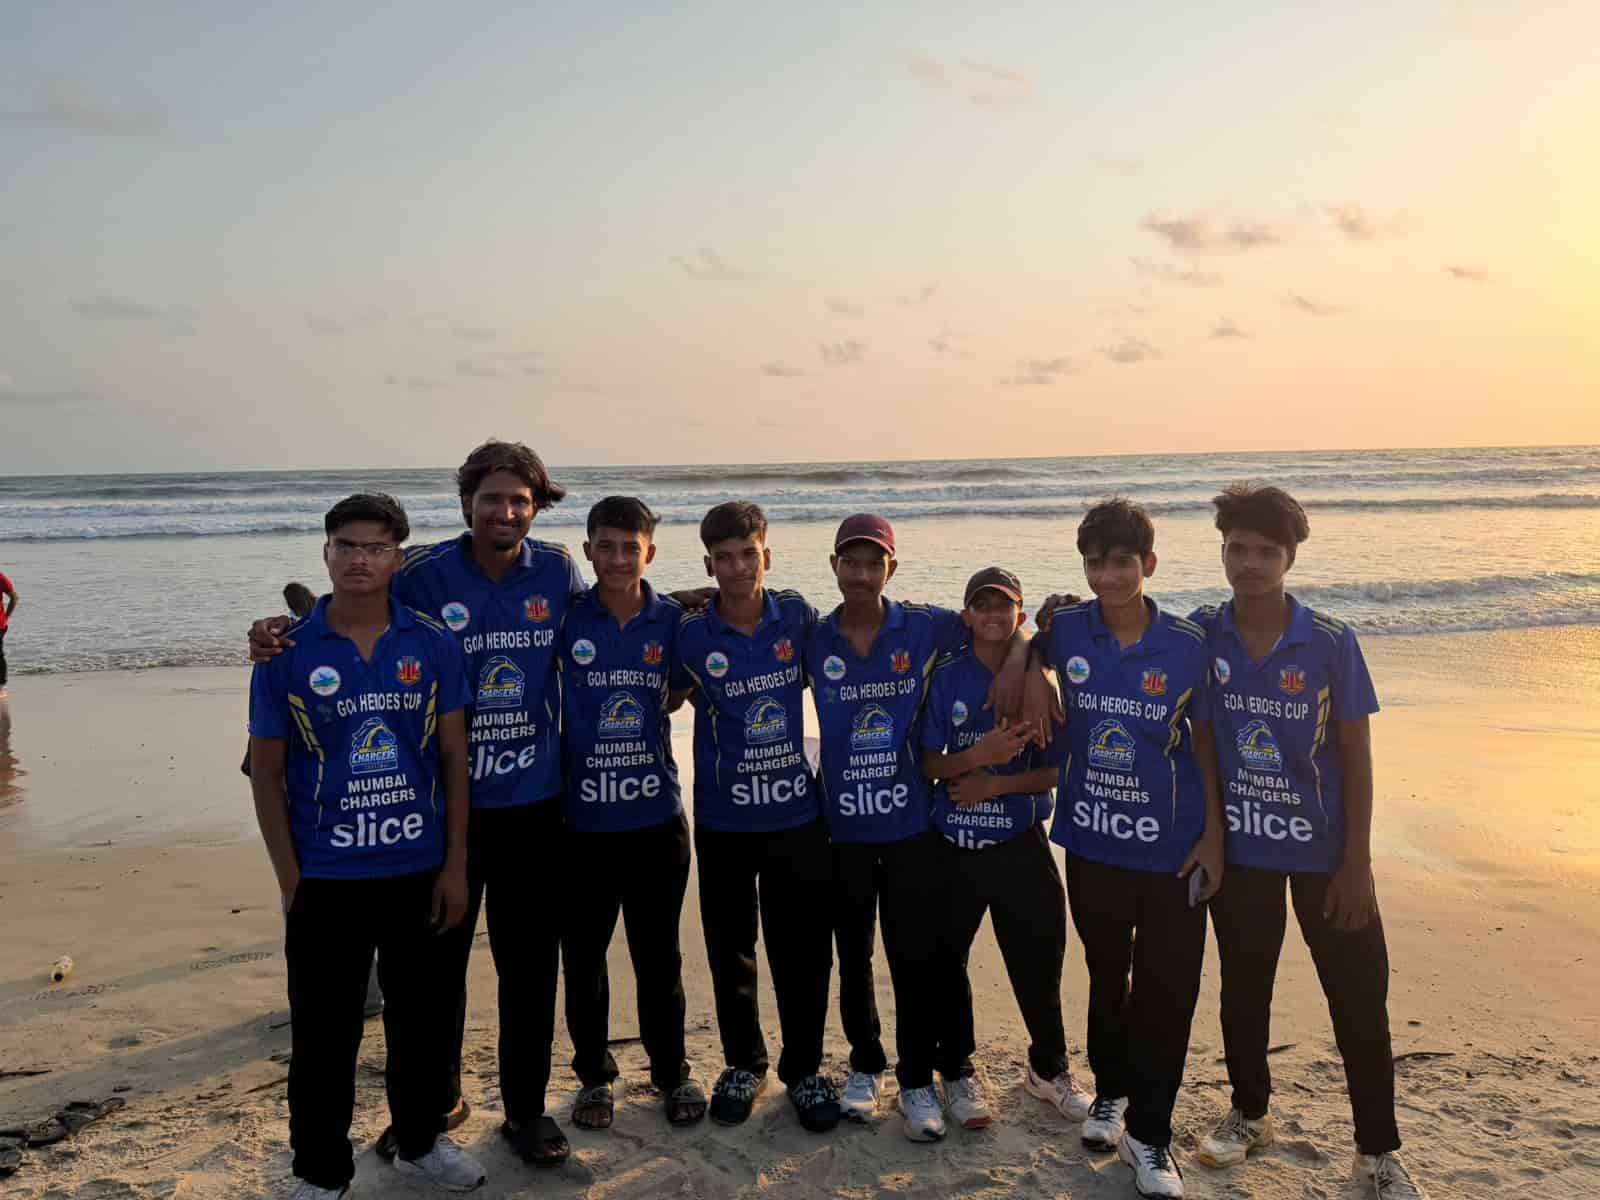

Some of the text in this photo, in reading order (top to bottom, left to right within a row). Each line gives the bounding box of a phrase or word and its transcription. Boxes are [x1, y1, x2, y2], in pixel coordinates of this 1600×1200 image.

[463, 628, 554, 654] GOA HEROES CUP
[587, 671, 607, 688] GOA
[609, 670, 645, 686] HEROES
[725, 680, 746, 697] GOA
[746, 671, 785, 694] HEROES
[840, 678, 916, 701] GOA HEROES CUP
[403, 693, 422, 711] CUP
[1078, 692, 1167, 721] GOA HEROES CUP
[1246, 696, 1281, 718] EROES
[1285, 702, 1309, 720] CUP
[472, 711, 528, 729] MUMBAI
[468, 724, 536, 743] HARGERS
[595, 741, 646, 755] MUMBAI
[744, 741, 793, 760] MUMBAI
[468, 744, 536, 780] lice
[586, 753, 654, 768] CHARGERS
[737, 752, 801, 773] CHARGERS
[849, 752, 897, 768] MUMBAI
[347, 773, 407, 794] MUMBAI
[580, 771, 661, 803] slice
[731, 773, 807, 805] slice
[1086, 768, 1140, 788] MUMBAI
[340, 787, 416, 811] CHARGERS
[839, 783, 908, 816] slice
[1084, 783, 1150, 804] HARGERS
[330, 811, 423, 848] slice
[946, 813, 1013, 829] CHARGERS
[1072, 800, 1160, 842] slice
[1225, 799, 1313, 842] slice
